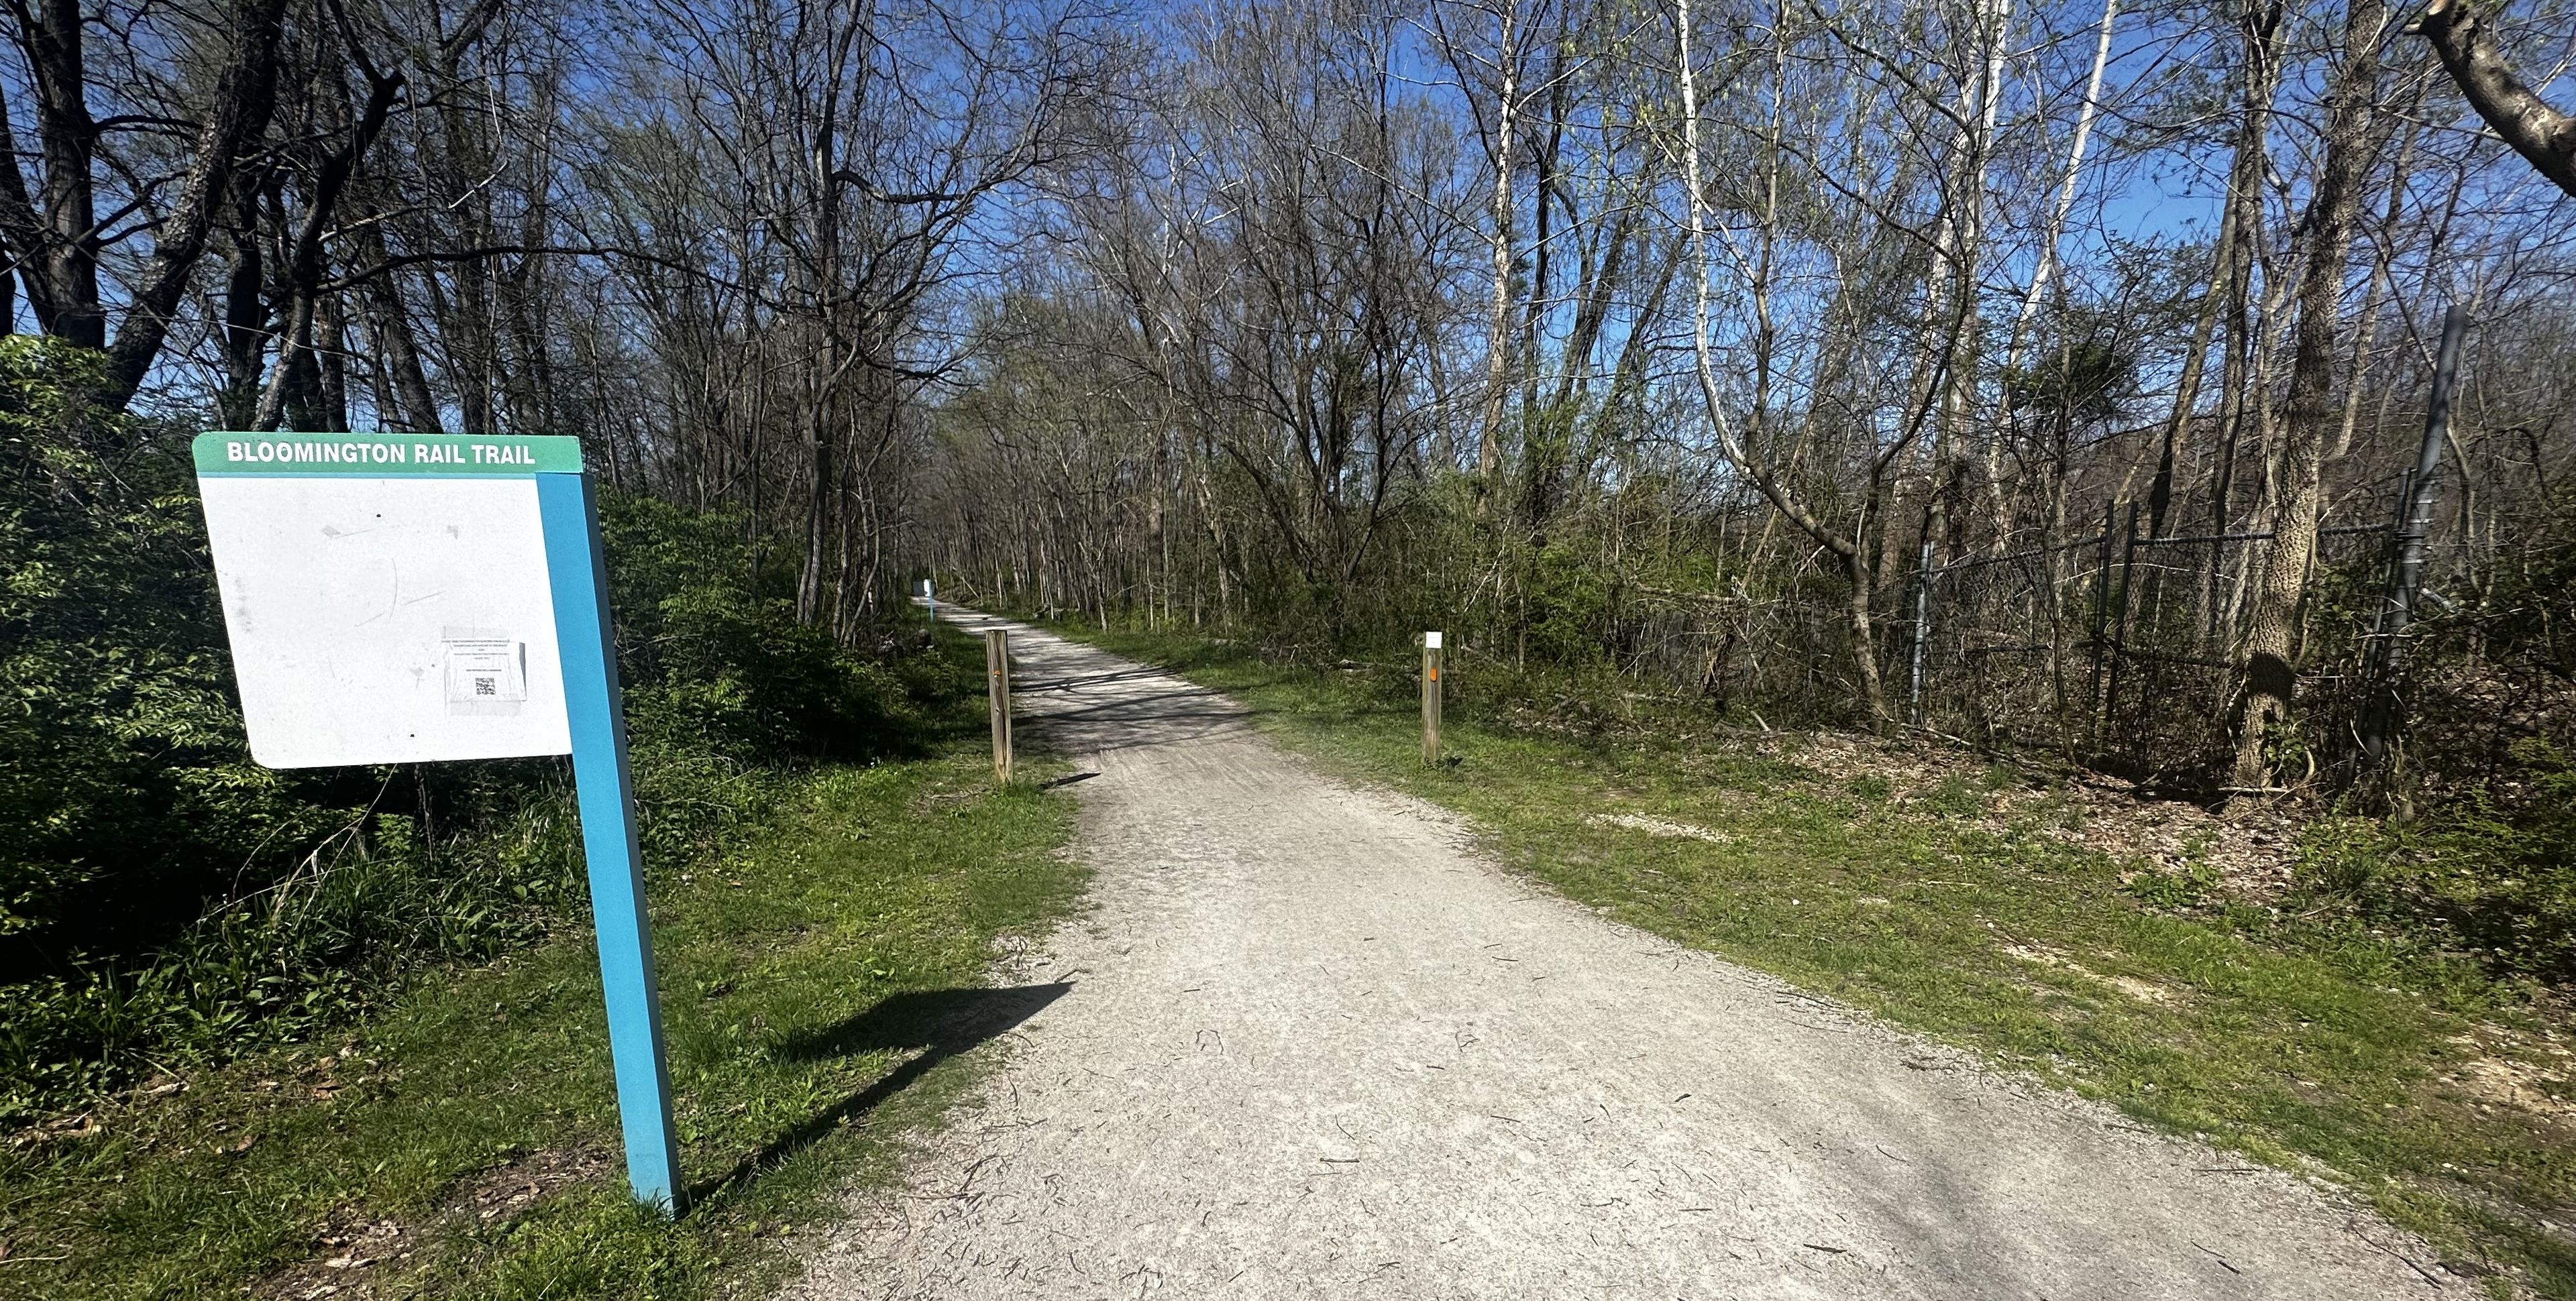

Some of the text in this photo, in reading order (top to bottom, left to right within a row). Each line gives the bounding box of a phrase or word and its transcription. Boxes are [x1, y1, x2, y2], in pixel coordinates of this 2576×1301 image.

[227, 441, 536, 465] BLOOMINGTON RAIL TRAIL
